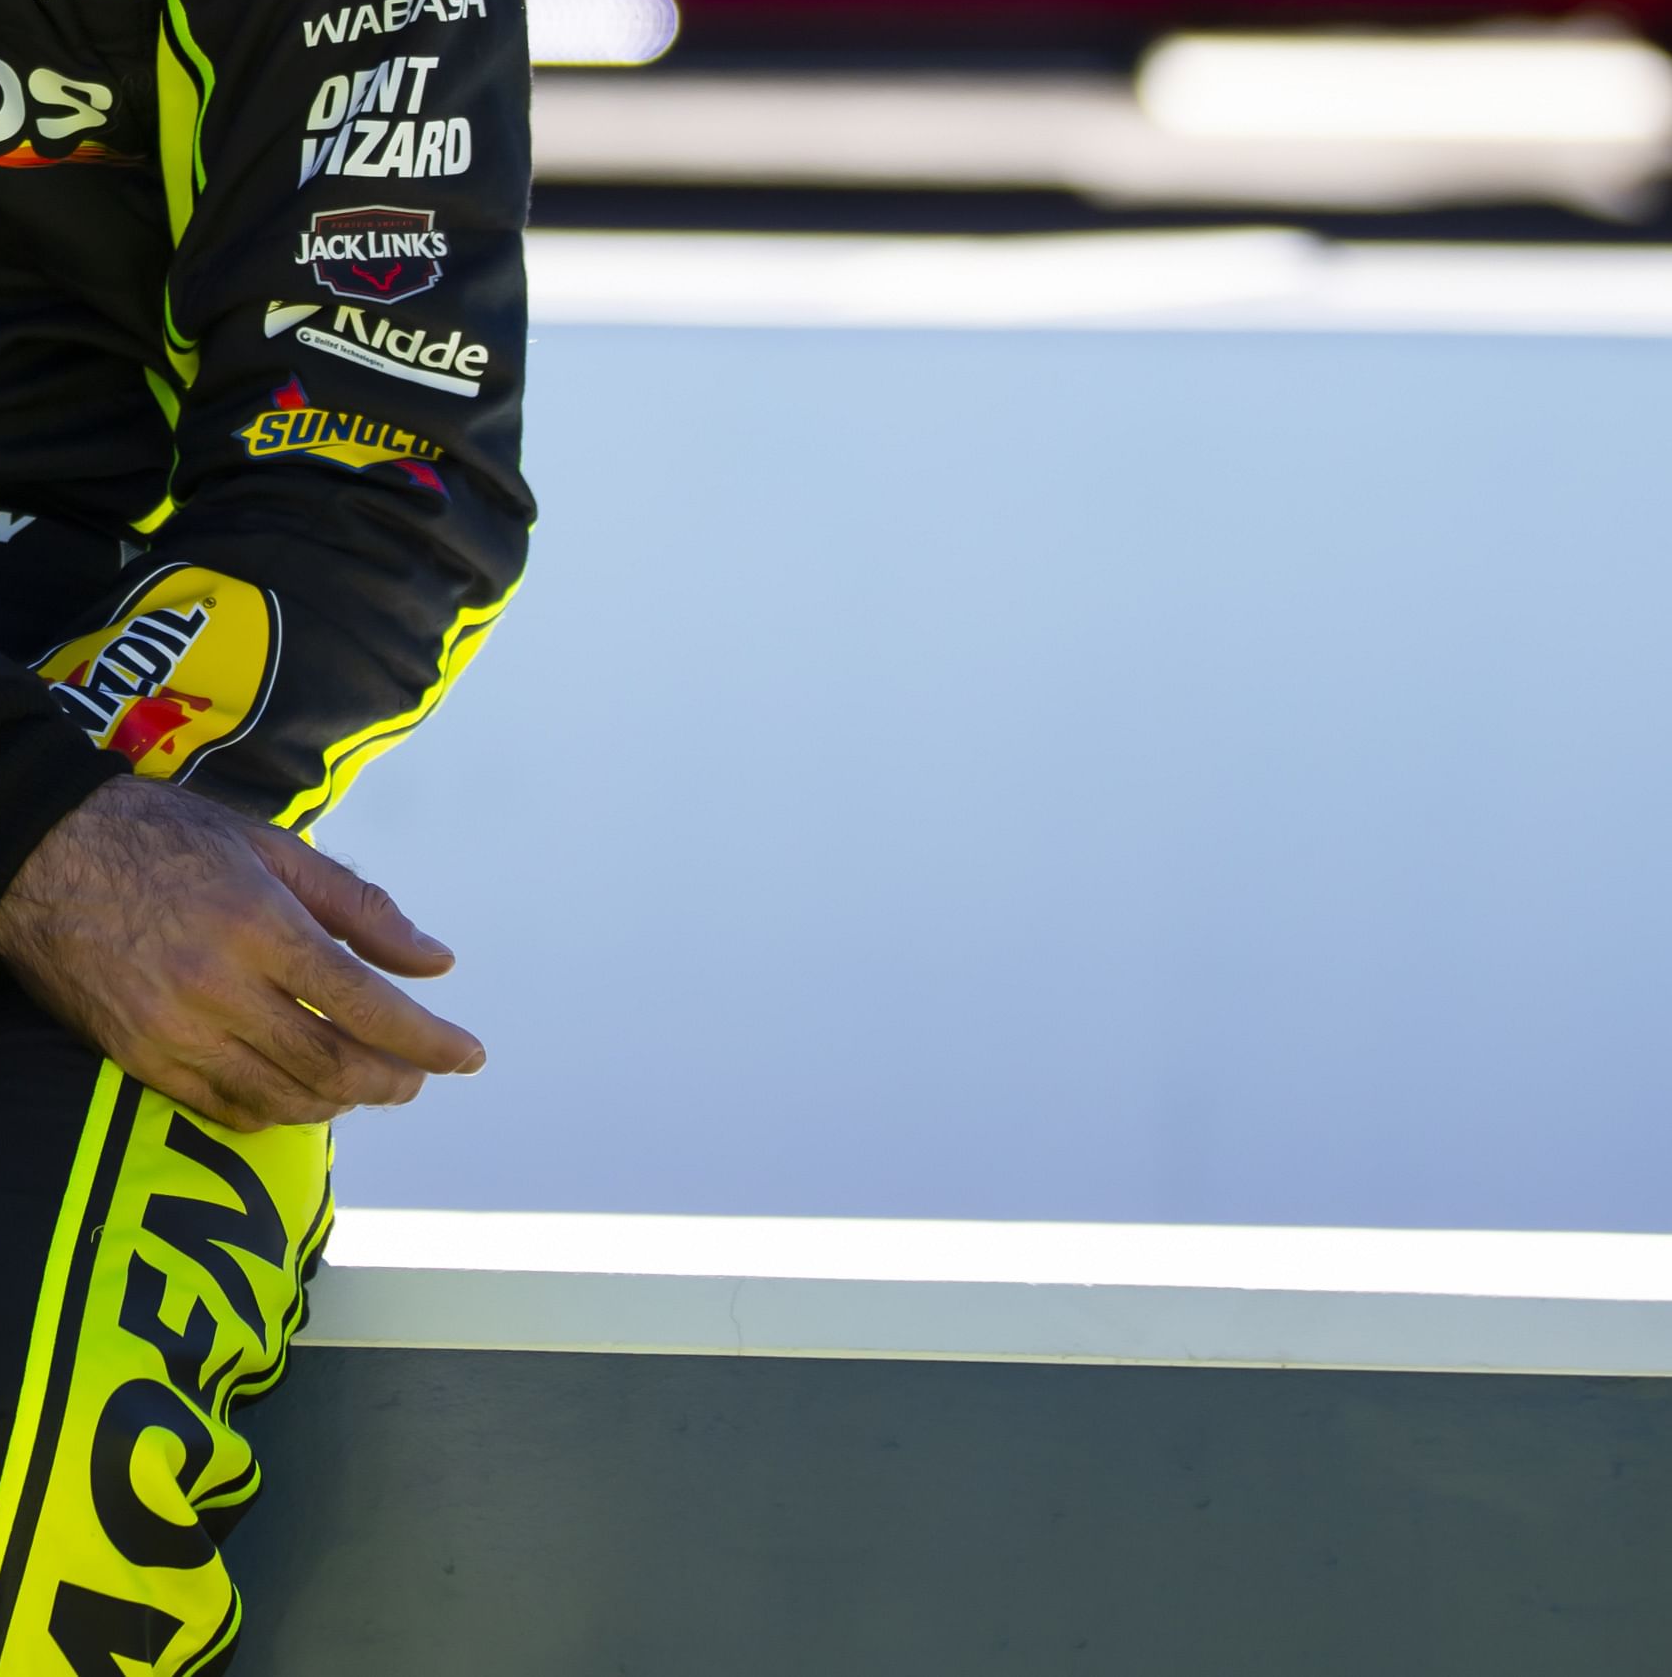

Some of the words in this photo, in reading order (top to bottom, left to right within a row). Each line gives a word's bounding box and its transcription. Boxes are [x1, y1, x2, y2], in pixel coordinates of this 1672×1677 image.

[307, 56, 440, 131] DENT
[295, 230, 367, 265] JACK
[367, 230, 448, 260] LINK'S
[333, 305, 489, 377] Kidde
[257, 409, 444, 460] SUNOCO
